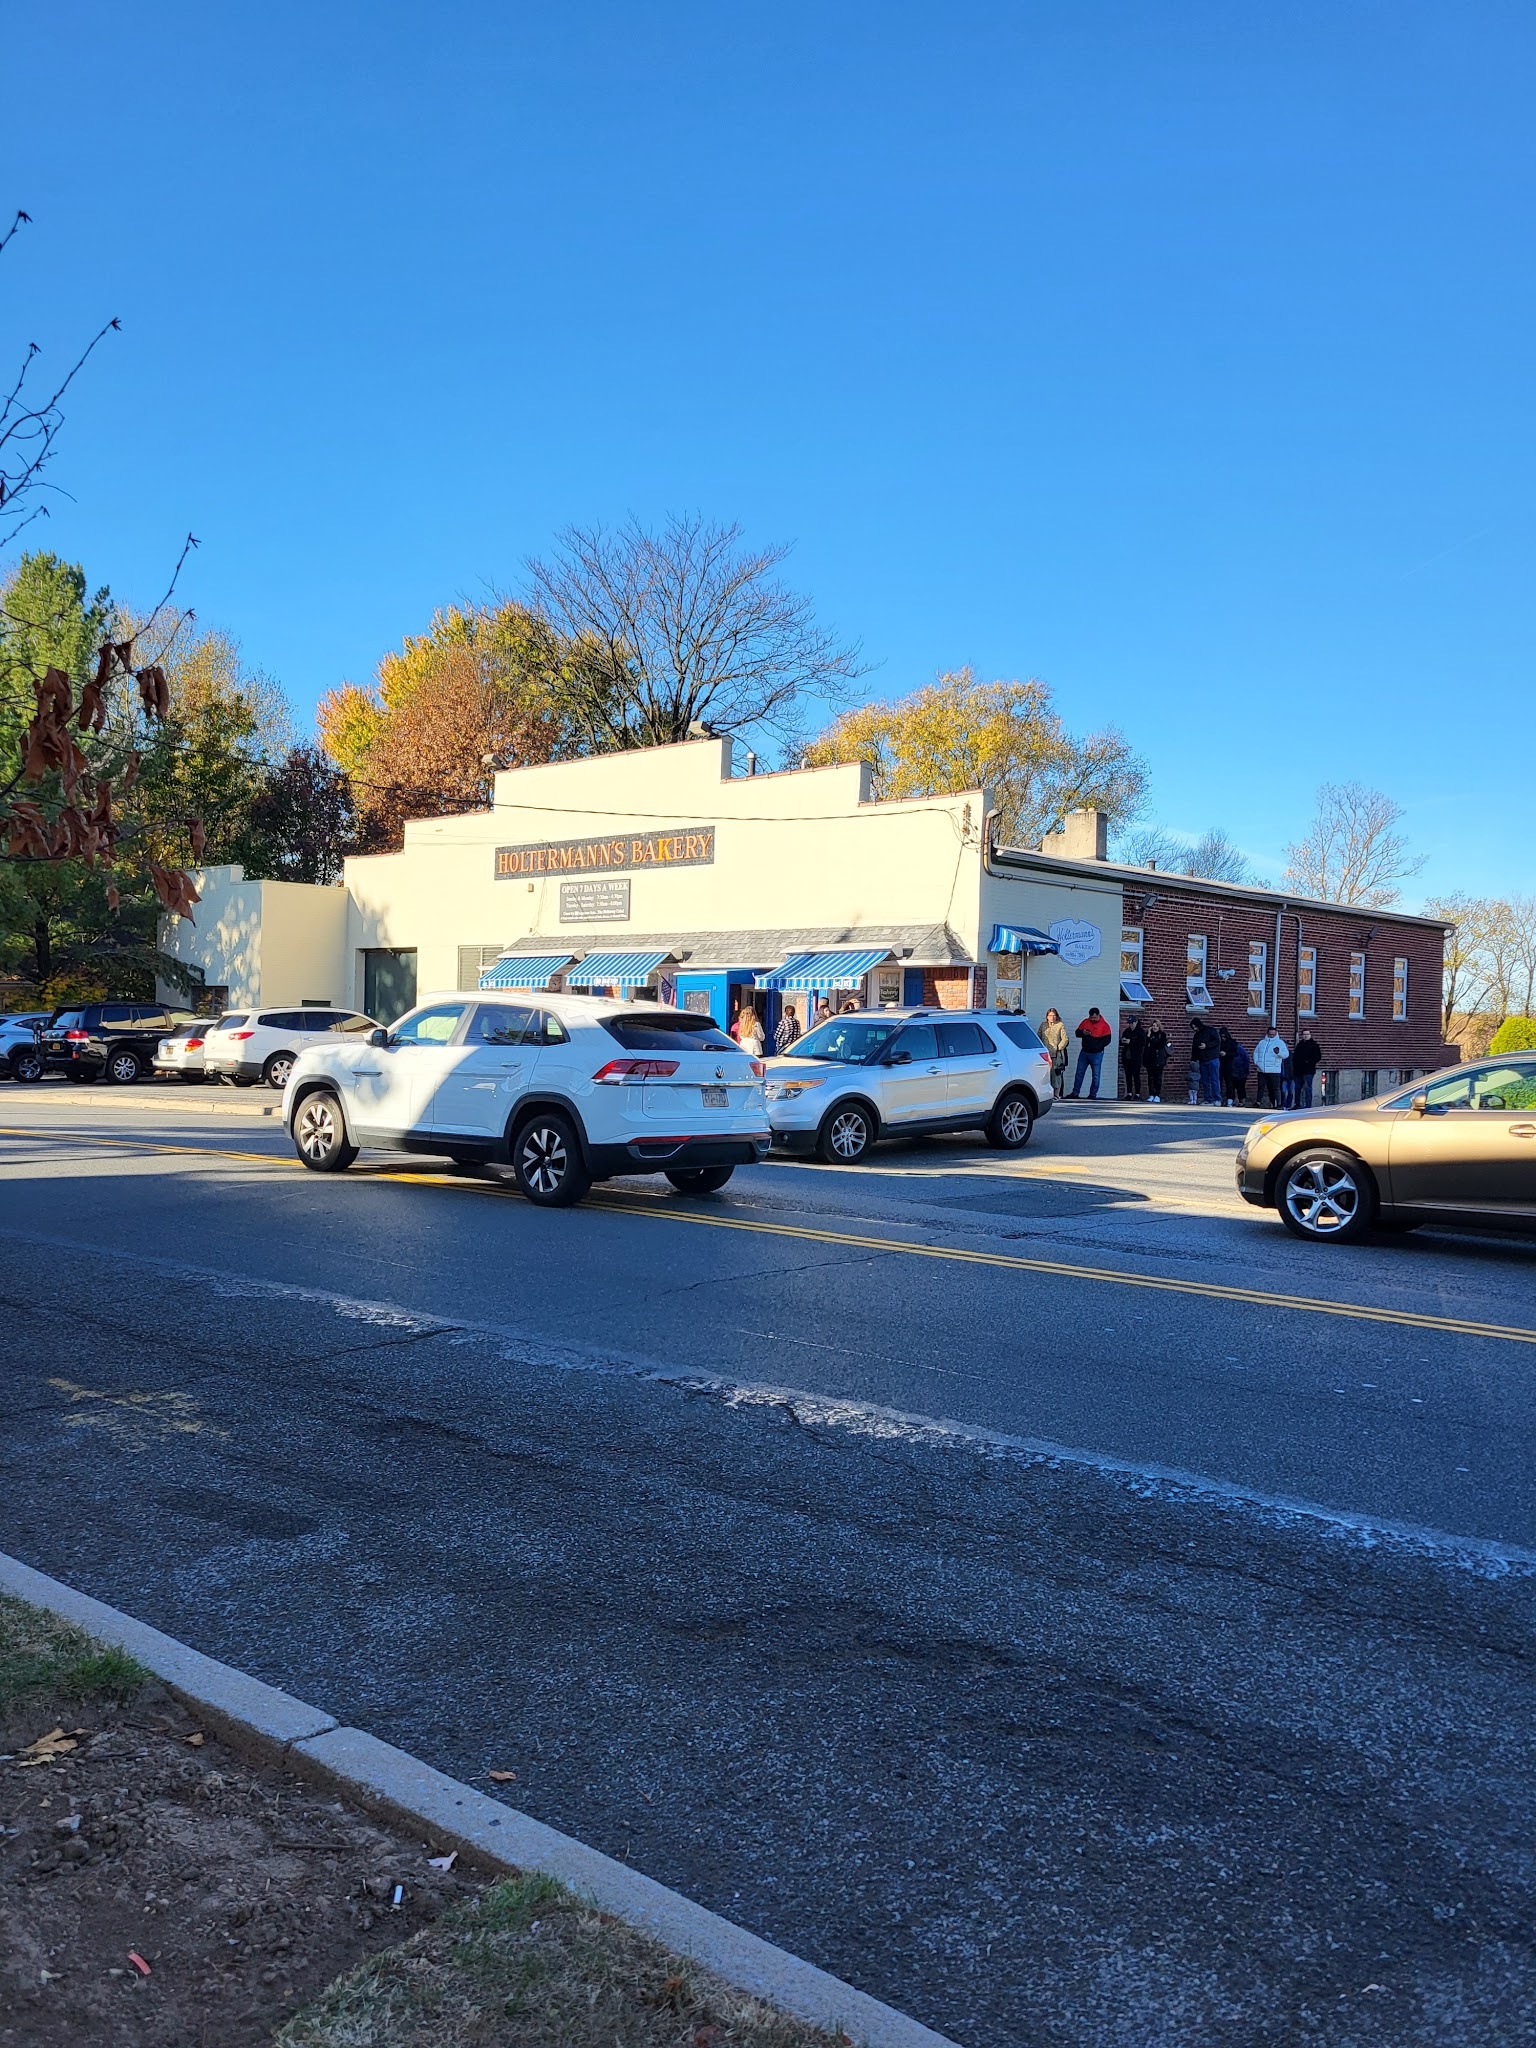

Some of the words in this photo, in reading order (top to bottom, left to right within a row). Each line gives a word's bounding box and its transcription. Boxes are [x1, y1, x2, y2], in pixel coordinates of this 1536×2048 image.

[497, 840, 626, 874] HOLTERMANN'S
[630, 833, 714, 864] BAKERY
[561, 885, 579, 894] OPEN
[584, 883, 602, 893] DAYS
[602, 883, 608, 892] A
[608, 882, 628, 891] WEEK
[1074, 943, 1095, 951] BAKERY
